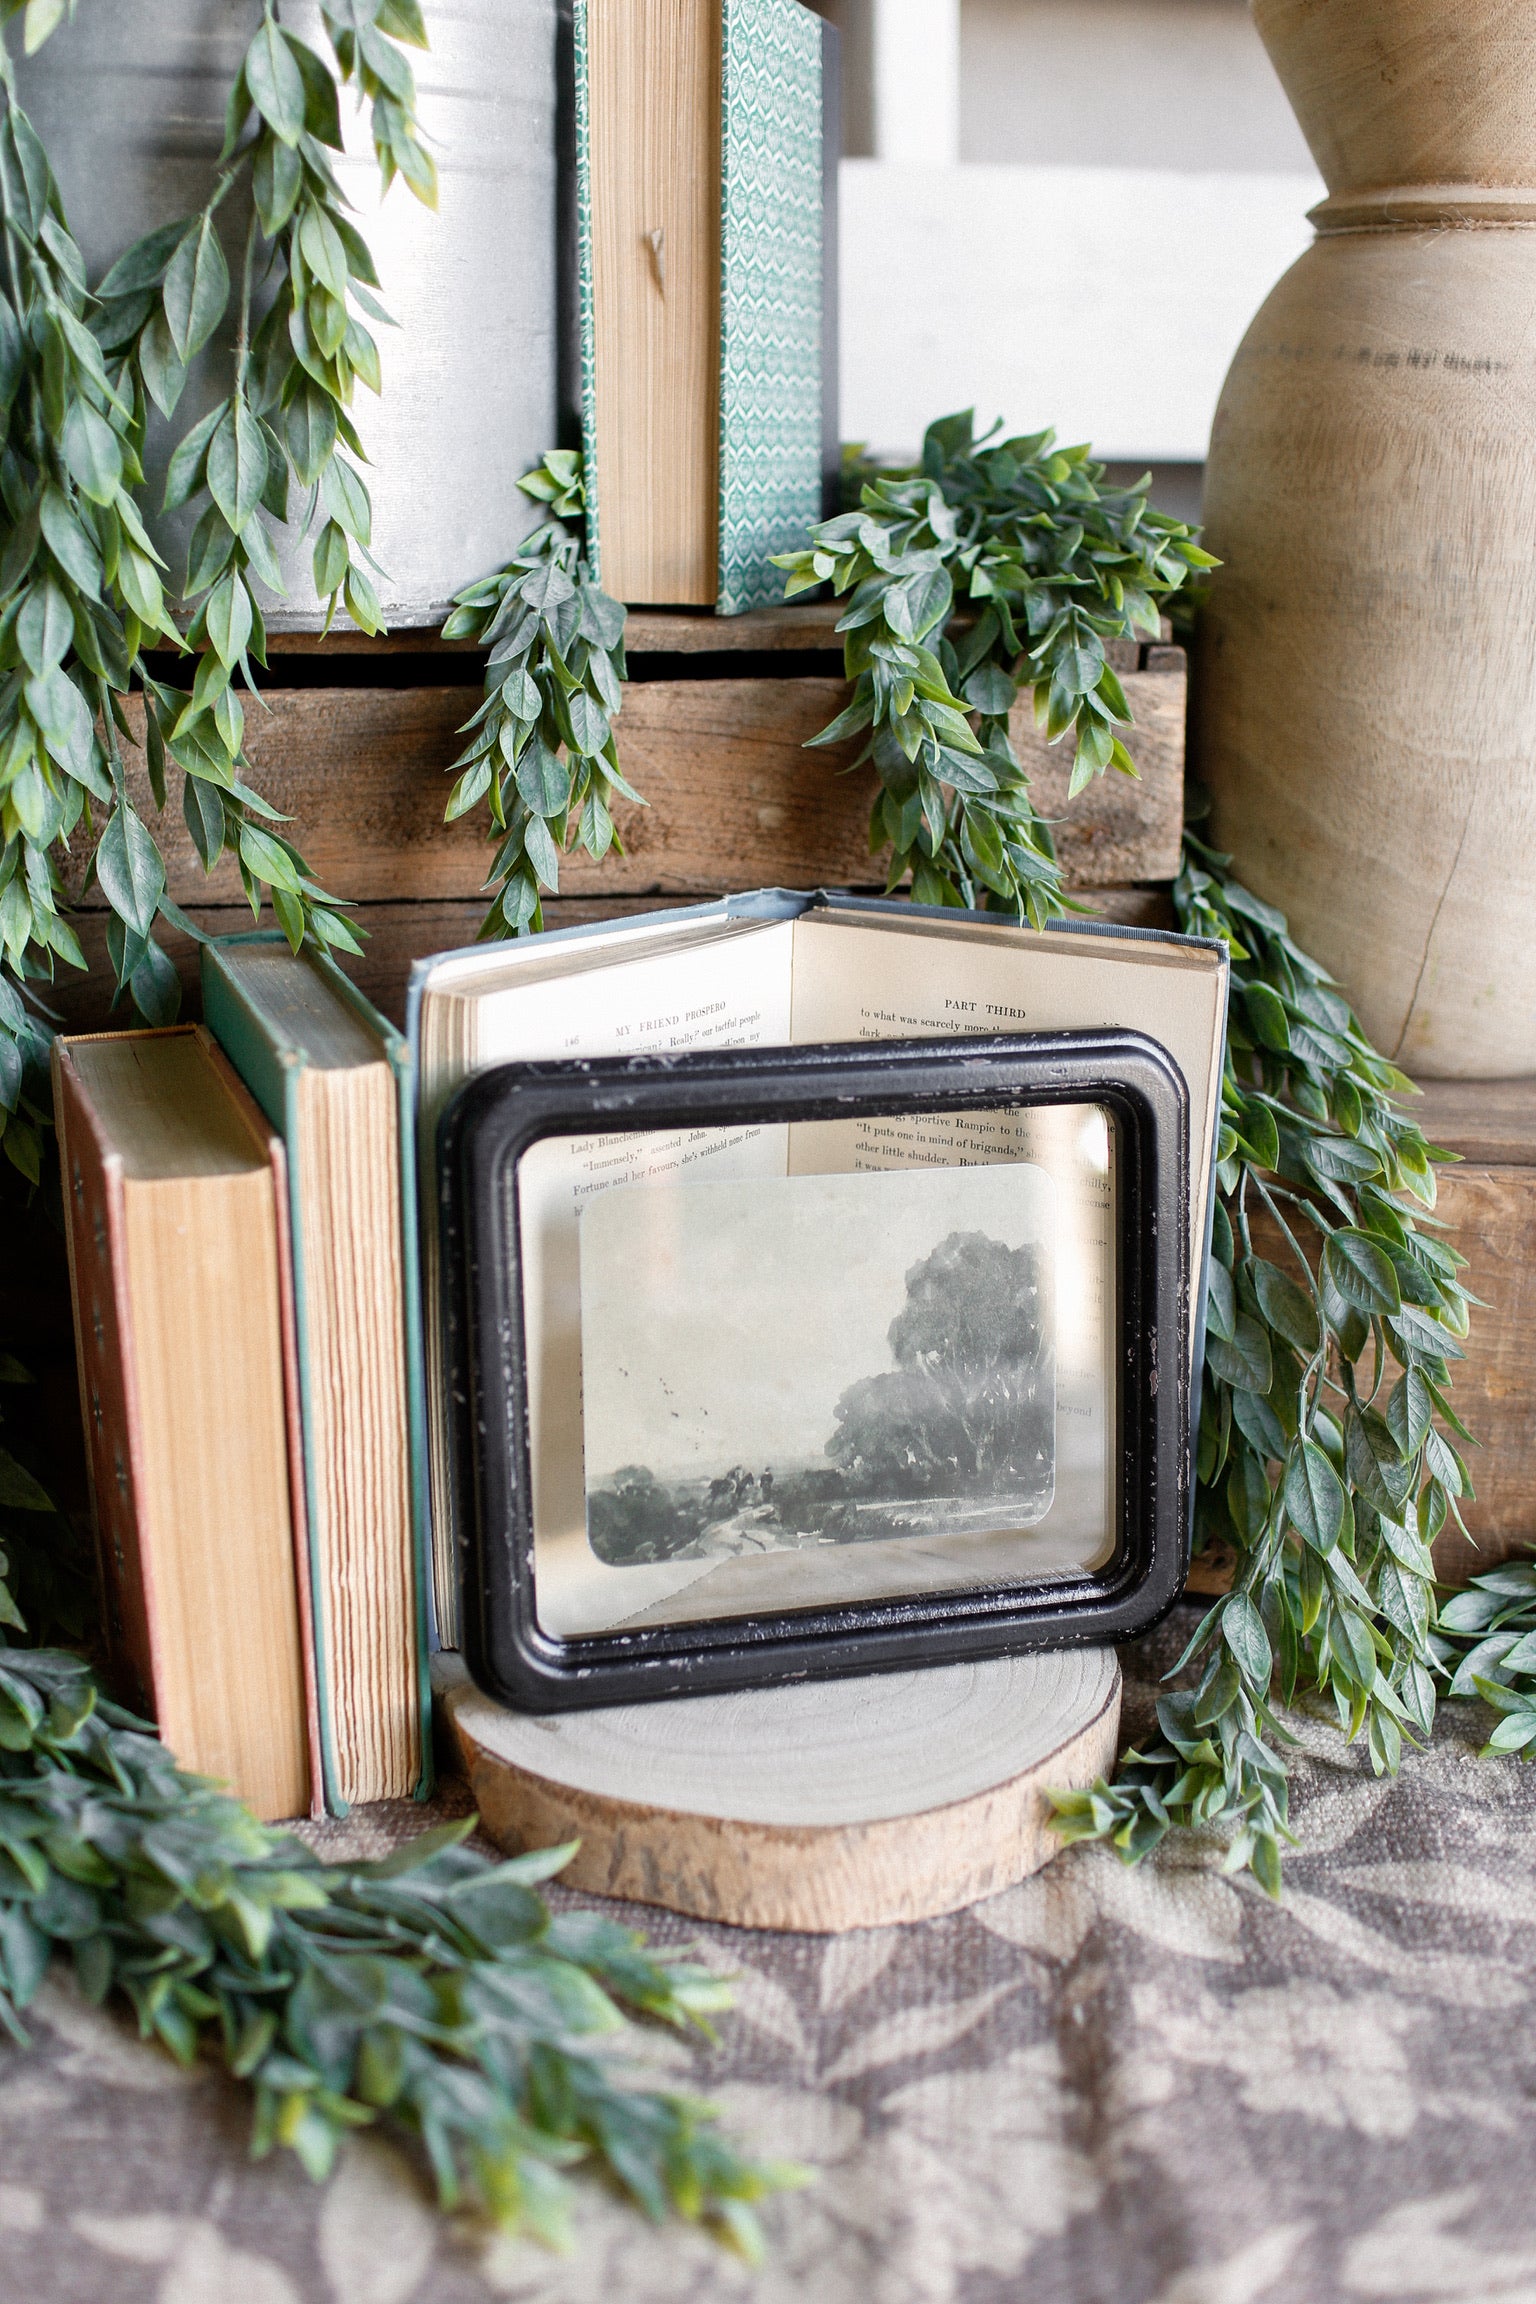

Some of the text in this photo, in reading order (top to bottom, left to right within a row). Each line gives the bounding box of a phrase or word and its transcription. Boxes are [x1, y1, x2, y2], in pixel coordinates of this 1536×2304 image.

[616, 1001, 726, 1037] MY FRIEND PROSPERO
[860, 1008, 870, 1018] to
[873, 1010, 896, 1022] what
[900, 1016, 917, 1025] was
[920, 1020, 960, 1032] scarcely
[945, 1000, 1026, 1019] PART THIRD
[702, 1028, 713, 1037] our
[715, 1017, 737, 1032] tactful
[740, 1011, 761, 1028] people
[859, 1026, 880, 1038] dark
[750, 1032, 760, 1042] my
[1004, 1108, 1020, 1117] the
[910, 1115, 950, 1127] sportive
[955, 1118, 995, 1134] Rampio
[1000, 1126, 1010, 1135] to
[1016, 1127, 1031, 1138] the
[571, 1141, 594, 1154] Lady
[650, 1137, 681, 1154] assented
[688, 1130, 707, 1143] John.
[874, 1127, 895, 1137] puts
[897, 1131, 914, 1140] one
[917, 1131, 926, 1142] in
[929, 1135, 953, 1147] mind
[956, 1139, 968, 1148] of
[573, 1181, 609, 1196] Fortune
[612, 1172, 628, 1186] and
[632, 1170, 645, 1181] her
[648, 1160, 679, 1176] favours,
[681, 1152, 697, 1165] she's
[700, 1139, 727, 1157] withheld
[729, 1135, 743, 1147] none
[745, 1127, 761, 1140] from
[855, 1142, 879, 1153] other
[882, 1145, 905, 1158] little
[908, 1150, 949, 1165] shudder.
[960, 1158, 977, 1167] But
[855, 1159, 862, 1168] it
[1056, 1401, 1092, 1417] beyond
